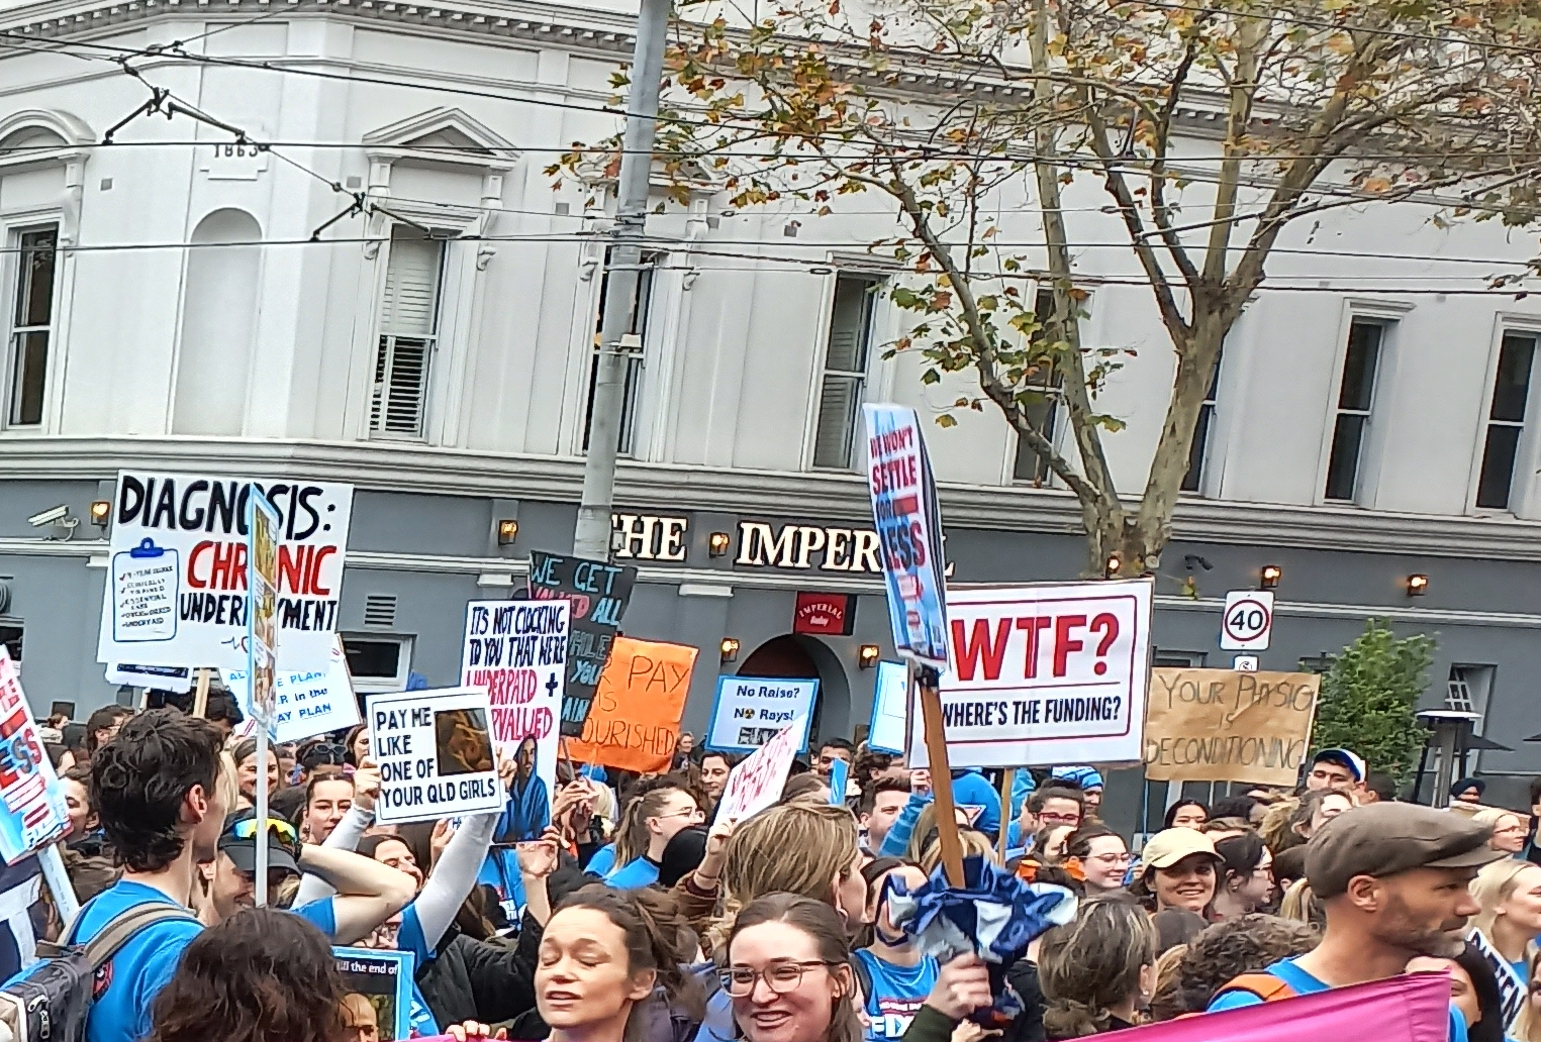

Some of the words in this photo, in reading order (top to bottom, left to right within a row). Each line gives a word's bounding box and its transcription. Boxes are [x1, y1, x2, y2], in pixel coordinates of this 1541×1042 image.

[883, 425, 913, 455] WON'T
[872, 455, 917, 496] SETTLE
[736, 521, 884, 573] IMPER
[532, 556, 564, 586] WE
[574, 561, 623, 594] GET
[180, 592, 338, 632] UNDERYMENT
[494, 605, 516, 635] NOT
[515, 605, 566, 635] CLOCKING
[591, 597, 623, 626] ALL
[798, 603, 843, 620] IMPERIAL
[1229, 609, 1264, 632] 40
[469, 637, 483, 666] TO
[483, 637, 505, 668] YOU
[508, 636, 539, 667] THAT
[951, 612, 1119, 682] WTF?
[628, 655, 690, 694] PAY
[597, 690, 617, 712] IS
[736, 685, 755, 698] No
[758, 685, 801, 700] Raise?
[1159, 672, 1225, 709] YOUR
[299, 702, 332, 718] PLAN
[376, 708, 407, 732] PAY
[411, 706, 432, 728] ME
[759, 708, 794, 722] Rays!
[1012, 700, 1040, 725] THE
[1045, 695, 1122, 723] FUNDING?
[1219, 712, 1236, 730] IS
[377, 734, 413, 757] LIKE
[380, 760, 413, 782] ONE
[416, 757, 435, 779] OF
[381, 785, 424, 808] YOUR
[426, 782, 456, 804] QLD
[459, 778, 496, 800] GIRLS
[350, 960, 367, 973] the
[368, 961, 387, 975] end
